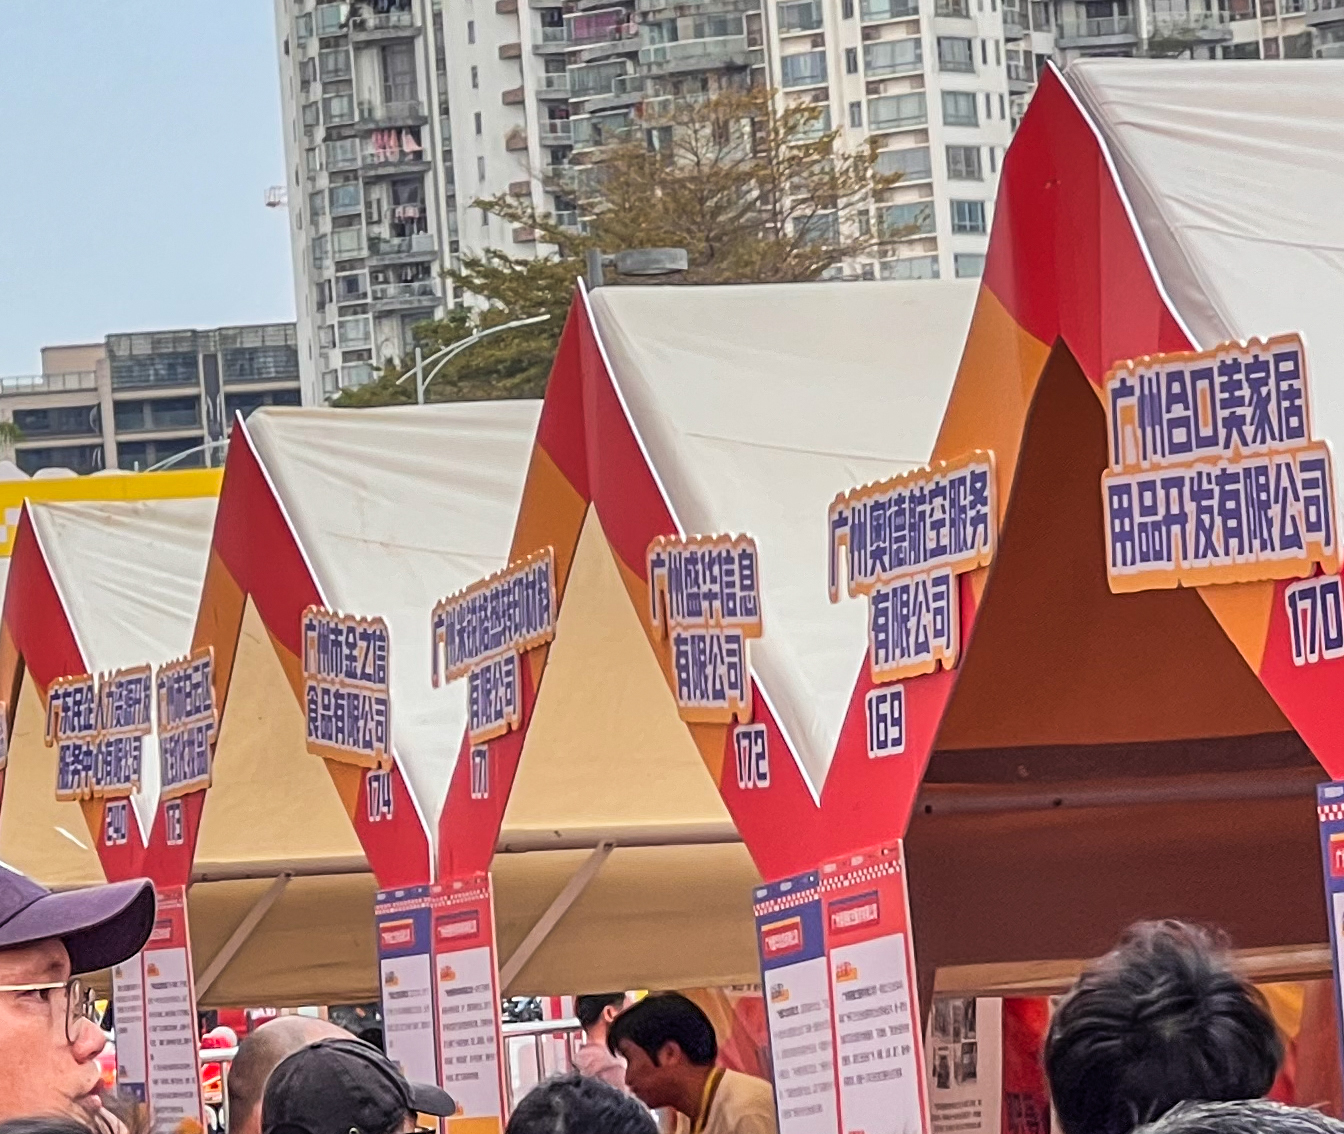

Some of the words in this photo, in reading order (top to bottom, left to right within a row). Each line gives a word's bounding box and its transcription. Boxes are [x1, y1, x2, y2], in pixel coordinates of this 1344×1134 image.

[1111, 349, 1305, 465] 广州合口美家居
[1110, 457, 1332, 568] 用品开发有限公司
[651, 548, 757, 621] 广州盛华信息
[872, 573, 950, 665] 有限公司
[1287, 580, 1344, 661] 170
[674, 632, 744, 704] 有限公司
[735, 729, 768, 783] 172
[867, 687, 903, 753] 169
